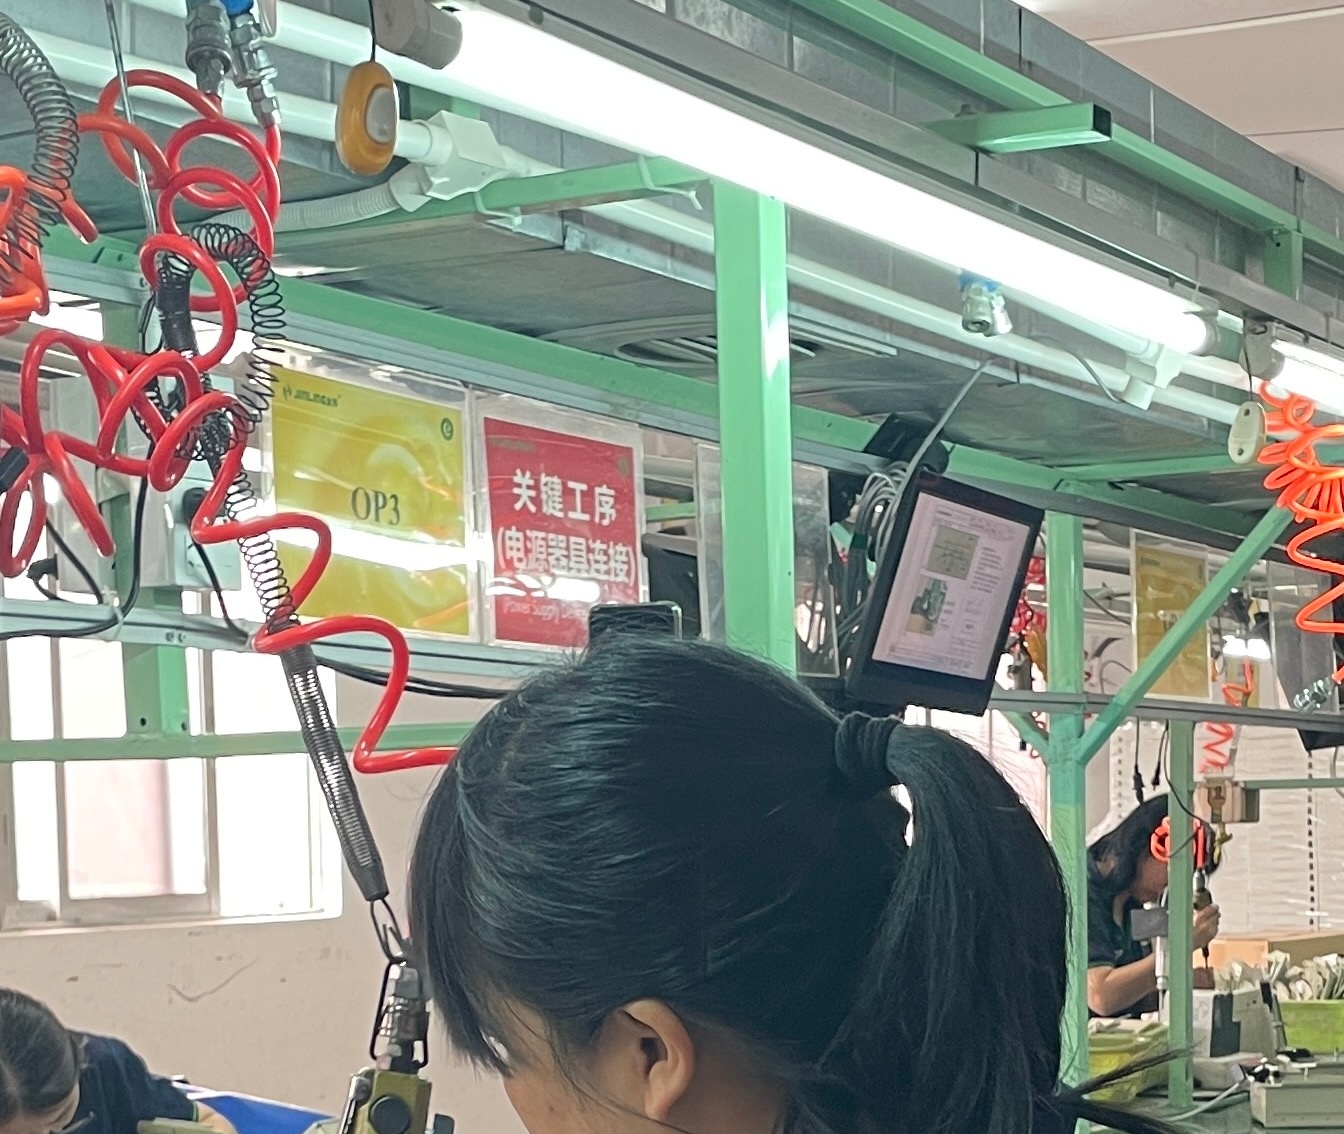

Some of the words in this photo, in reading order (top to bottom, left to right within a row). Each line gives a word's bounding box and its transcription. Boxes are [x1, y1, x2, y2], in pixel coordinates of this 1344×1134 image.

[350, 486, 400, 526] OP3
[512, 468, 616, 526] 关键工序
